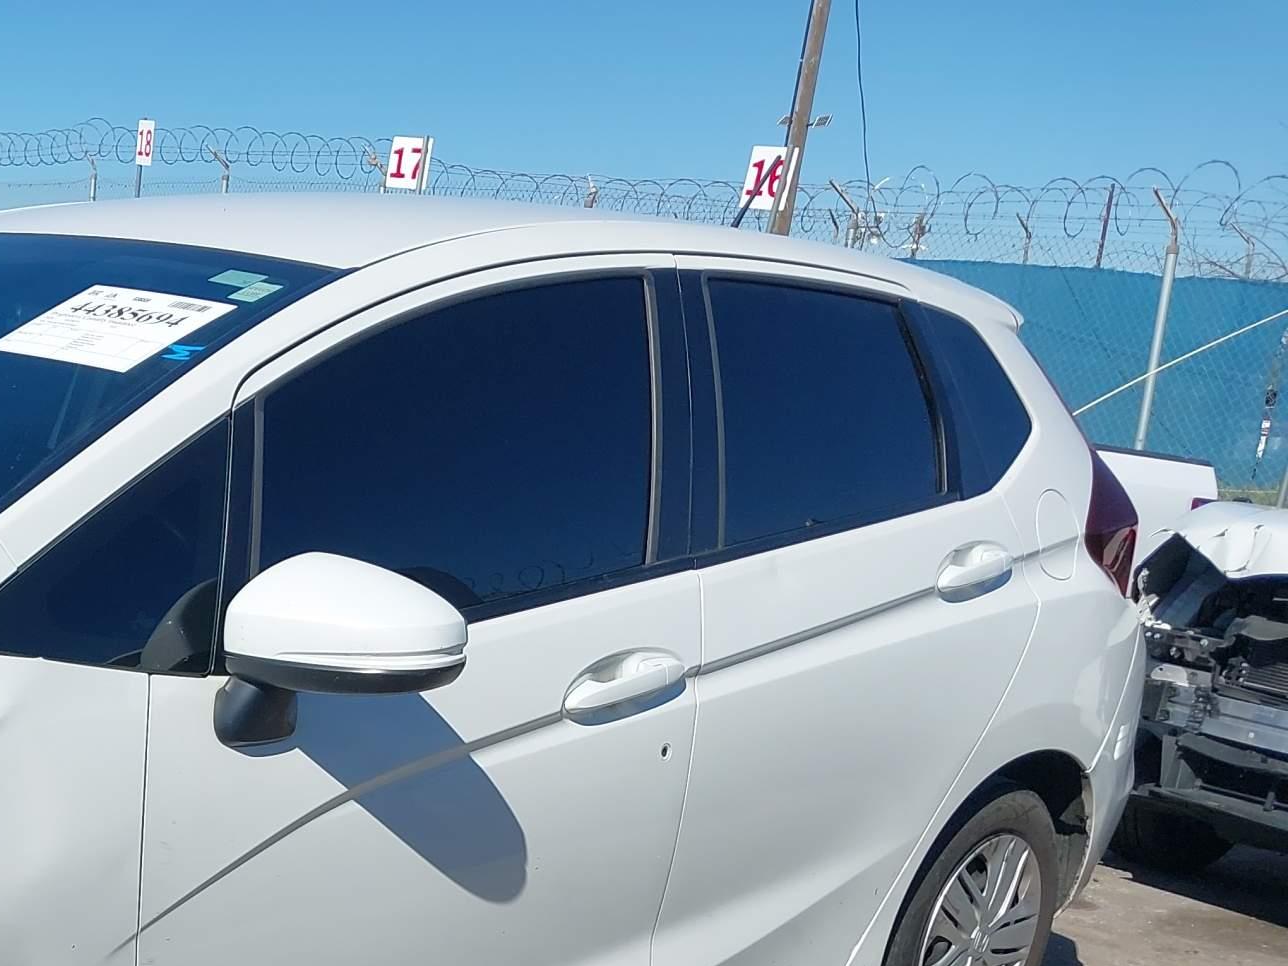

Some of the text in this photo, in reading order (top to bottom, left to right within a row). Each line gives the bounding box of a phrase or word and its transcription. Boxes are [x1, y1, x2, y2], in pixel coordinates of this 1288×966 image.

[138, 129, 152, 157] 18
[390, 147, 422, 180] 17
[70, 301, 190, 328] 44385694
